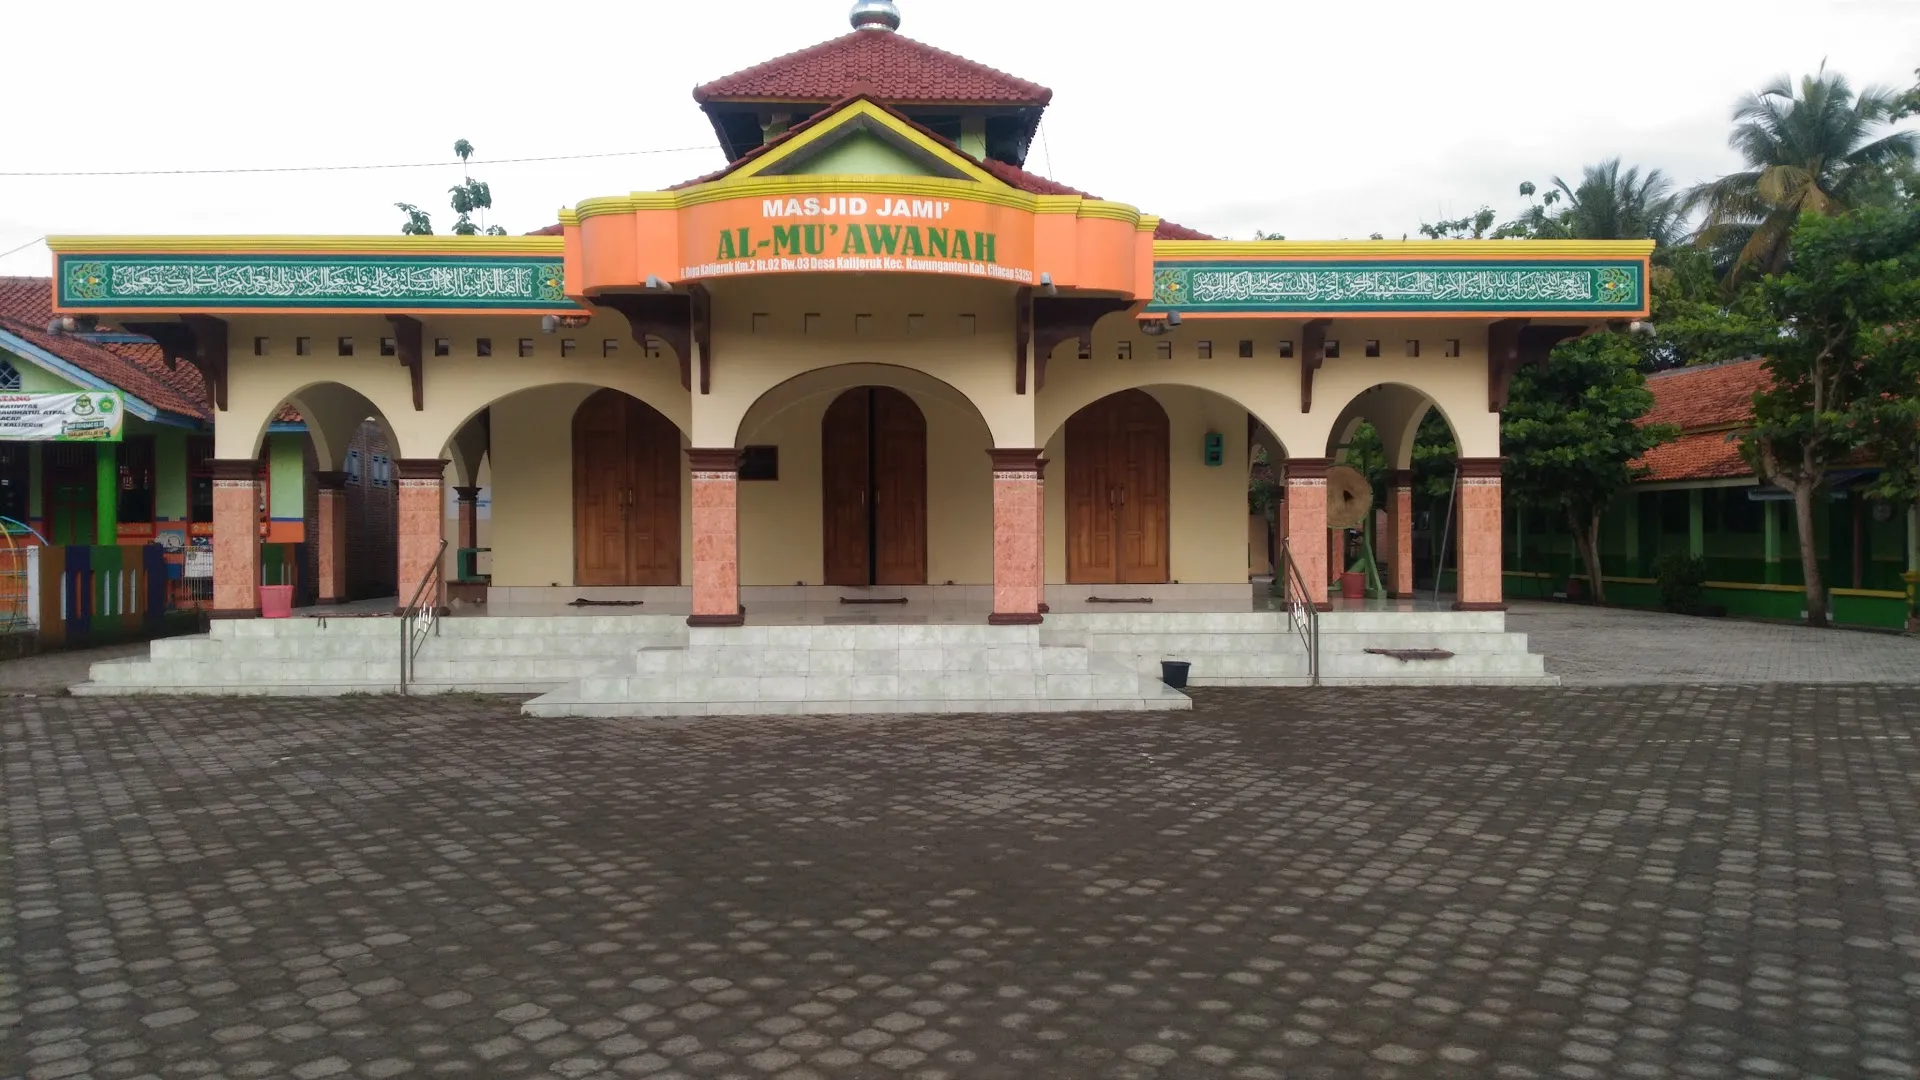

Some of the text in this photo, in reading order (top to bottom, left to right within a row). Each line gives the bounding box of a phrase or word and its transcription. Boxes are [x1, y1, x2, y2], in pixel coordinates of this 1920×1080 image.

[762, 197, 868, 218] MASJID
[700, 261, 734, 276] Kalijeruk
[735, 259, 755, 273] Km.2
[757, 258, 780, 271] Rt.02
[781, 256, 810, 270] Rw.03
[811, 256, 835, 269] Desa
[836, 256, 882, 271] Kalijeruk
[884, 257, 904, 270] Kec.
[906, 257, 969, 273] Kawunganten
[969, 261, 987, 275] Kab.
[987, 264, 1014, 280] Cilacap
[1014, 267, 1033, 282] 53253
